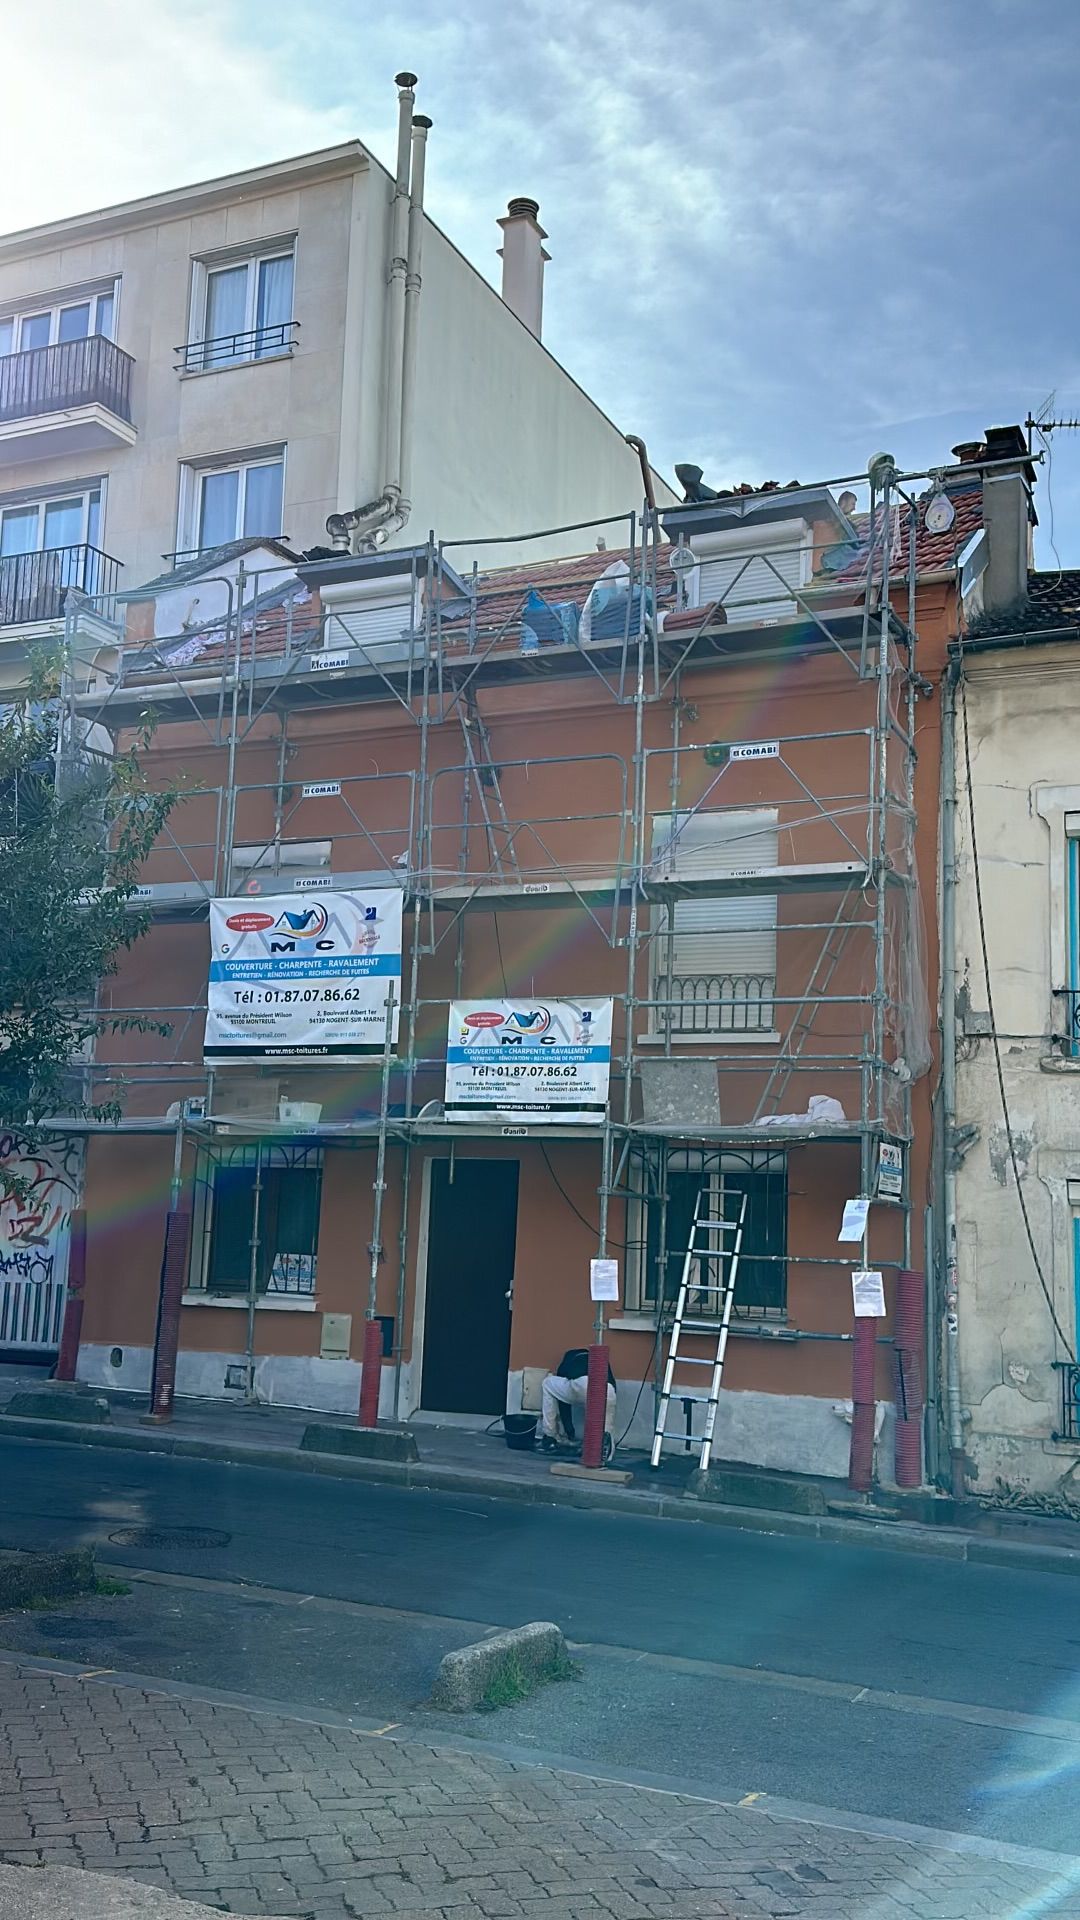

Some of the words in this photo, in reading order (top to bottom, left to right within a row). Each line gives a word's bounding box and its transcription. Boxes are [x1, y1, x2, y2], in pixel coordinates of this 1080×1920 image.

[319, 659, 349, 669] COMABI
[741, 747, 776, 756] COMABI
[311, 786, 339, 794] COMABI
[302, 879, 331, 887] COMABI
[225, 962, 273, 971] COUVERTURE
[279, 960, 322, 970] CHARPENTE
[328, 958, 379, 967] RAVALEMENT
[308, 969, 341, 977] RECHERCHE
[234, 991, 254, 1004] Tél
[264, 989, 360, 1003] 01.87.07.86.62
[264, 1046, 328, 1055] www.msc-toitures.fr
[472, 1066, 489, 1076] Tél
[497, 1066, 577, 1077] 01.87.07.86.62
